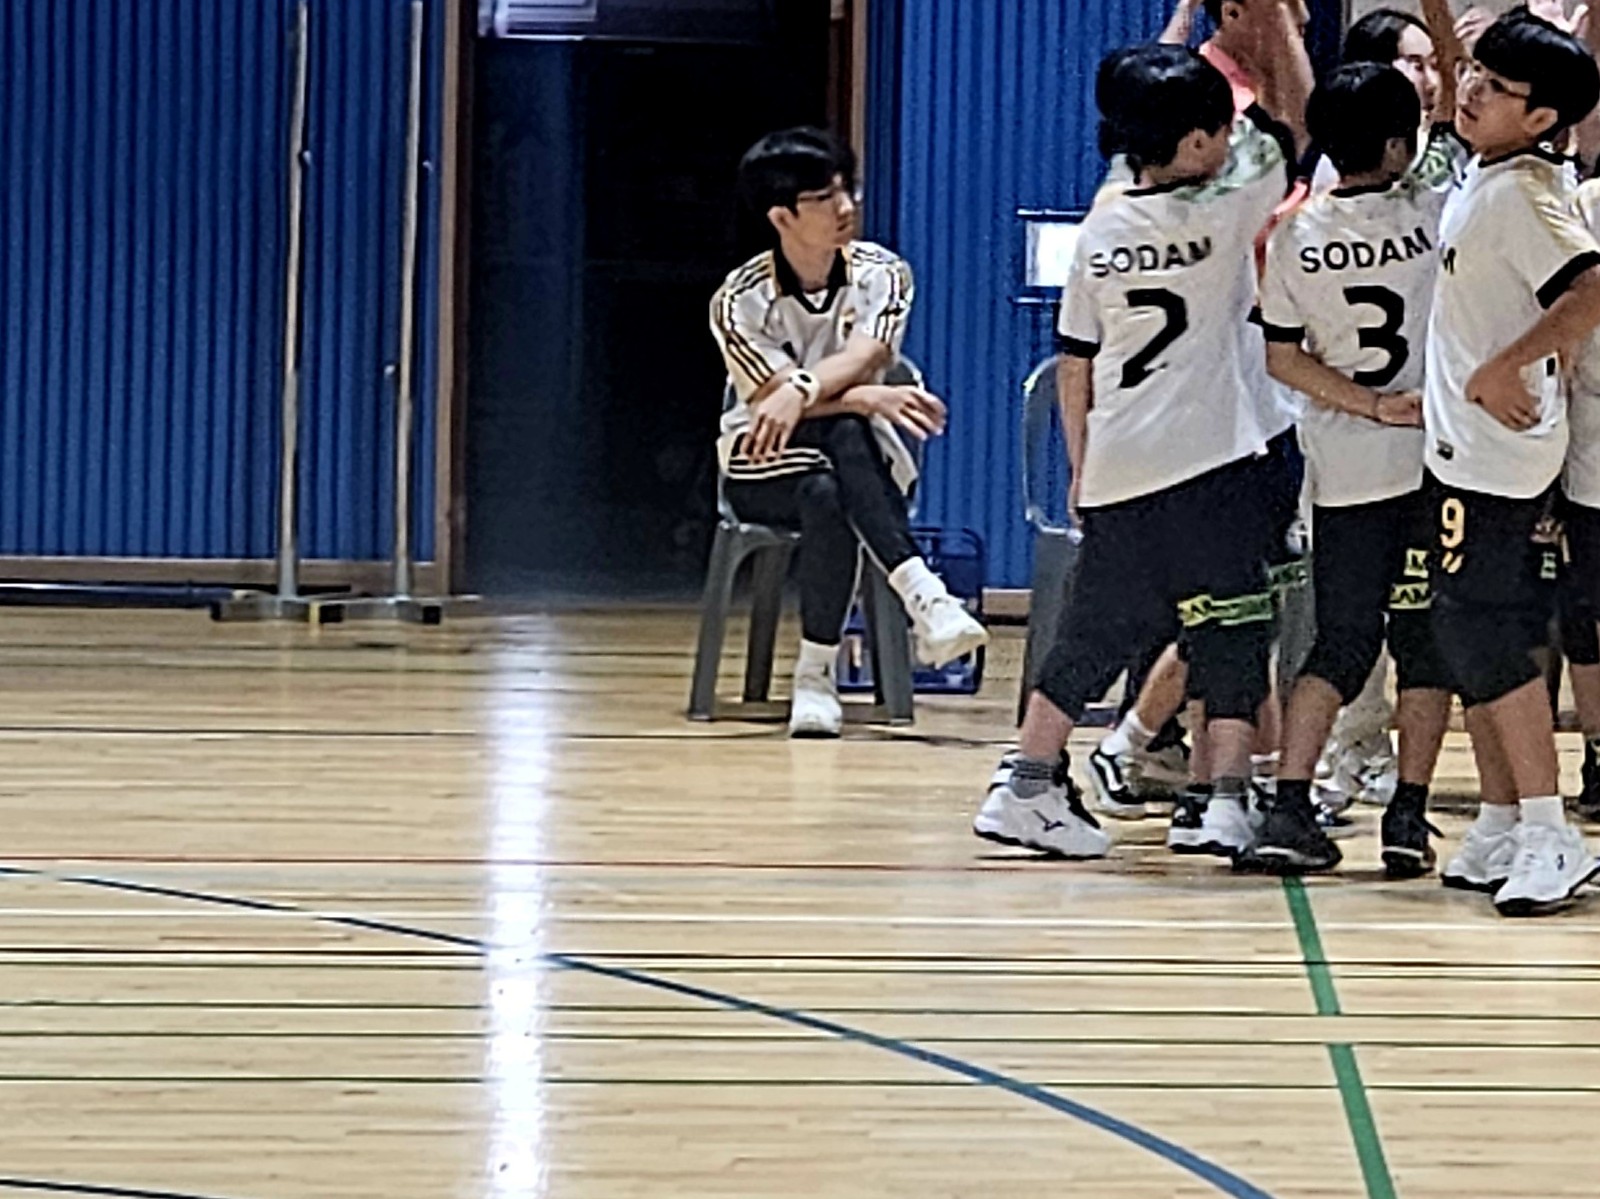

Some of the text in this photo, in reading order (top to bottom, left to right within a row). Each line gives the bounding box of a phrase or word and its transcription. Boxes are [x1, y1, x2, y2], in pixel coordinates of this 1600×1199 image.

[1089, 236, 1211, 278] SODAM
[1299, 226, 1433, 273] SODAM
[1119, 287, 1189, 388] 2
[1343, 285, 1410, 388] 3
[1440, 498, 1466, 549] 9
